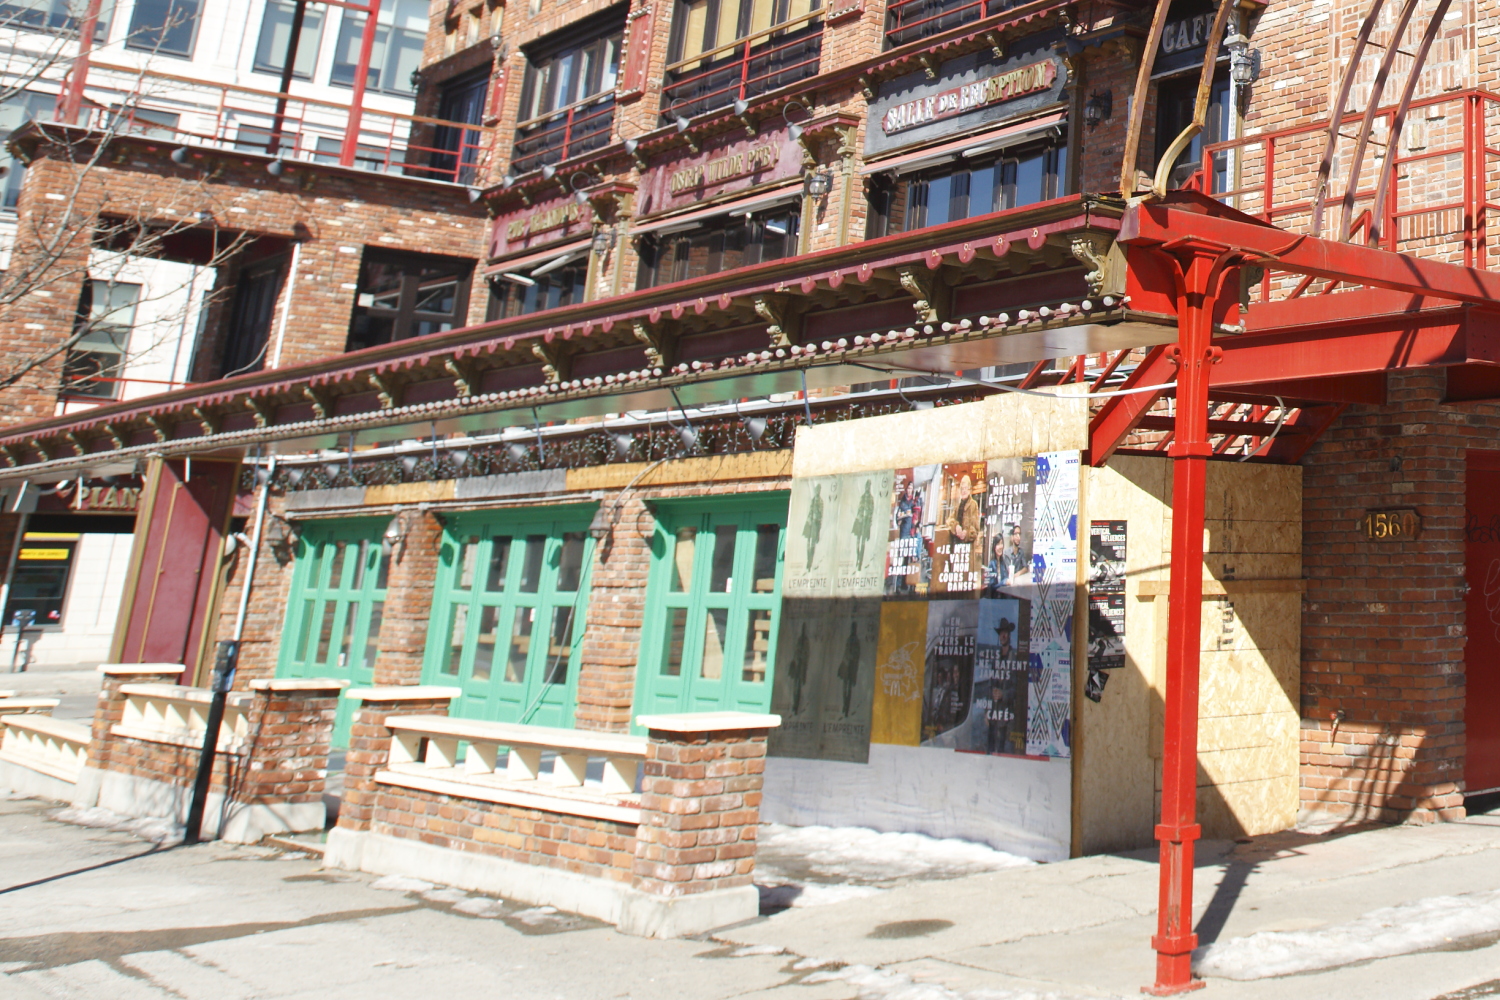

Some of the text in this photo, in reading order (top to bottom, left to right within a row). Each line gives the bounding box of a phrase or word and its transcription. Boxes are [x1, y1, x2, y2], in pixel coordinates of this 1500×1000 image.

[886, 94, 937, 131] SALLE
[938, 94, 958, 112] DE
[708, 154, 744, 183] WILDE
[993, 483, 1029, 496] MUSIQUE
[69, 486, 142, 510] PIAN
[988, 493, 1013, 506] ÉTAIT
[997, 502, 1023, 514] PLATE
[986, 514, 997, 525] AU
[1365, 513, 1414, 539] 1560
[889, 547, 917, 558] RITUEL
[950, 553, 970, 563] VAIS
[892, 557, 904, 567] DU
[943, 560, 970, 573] À MON
[938, 572, 964, 583] COURS
[968, 571, 979, 582] DE
[934, 626, 960, 637] OUTE
[939, 636, 975, 647] VERS LE
[934, 645, 975, 656] TRAVAIL»
[979, 659, 1028, 671] NE RATENT
[979, 669, 1011, 680] JAMAIS
[976, 699, 993, 710] MON
[986, 707, 1015, 721] CAFÉ»
